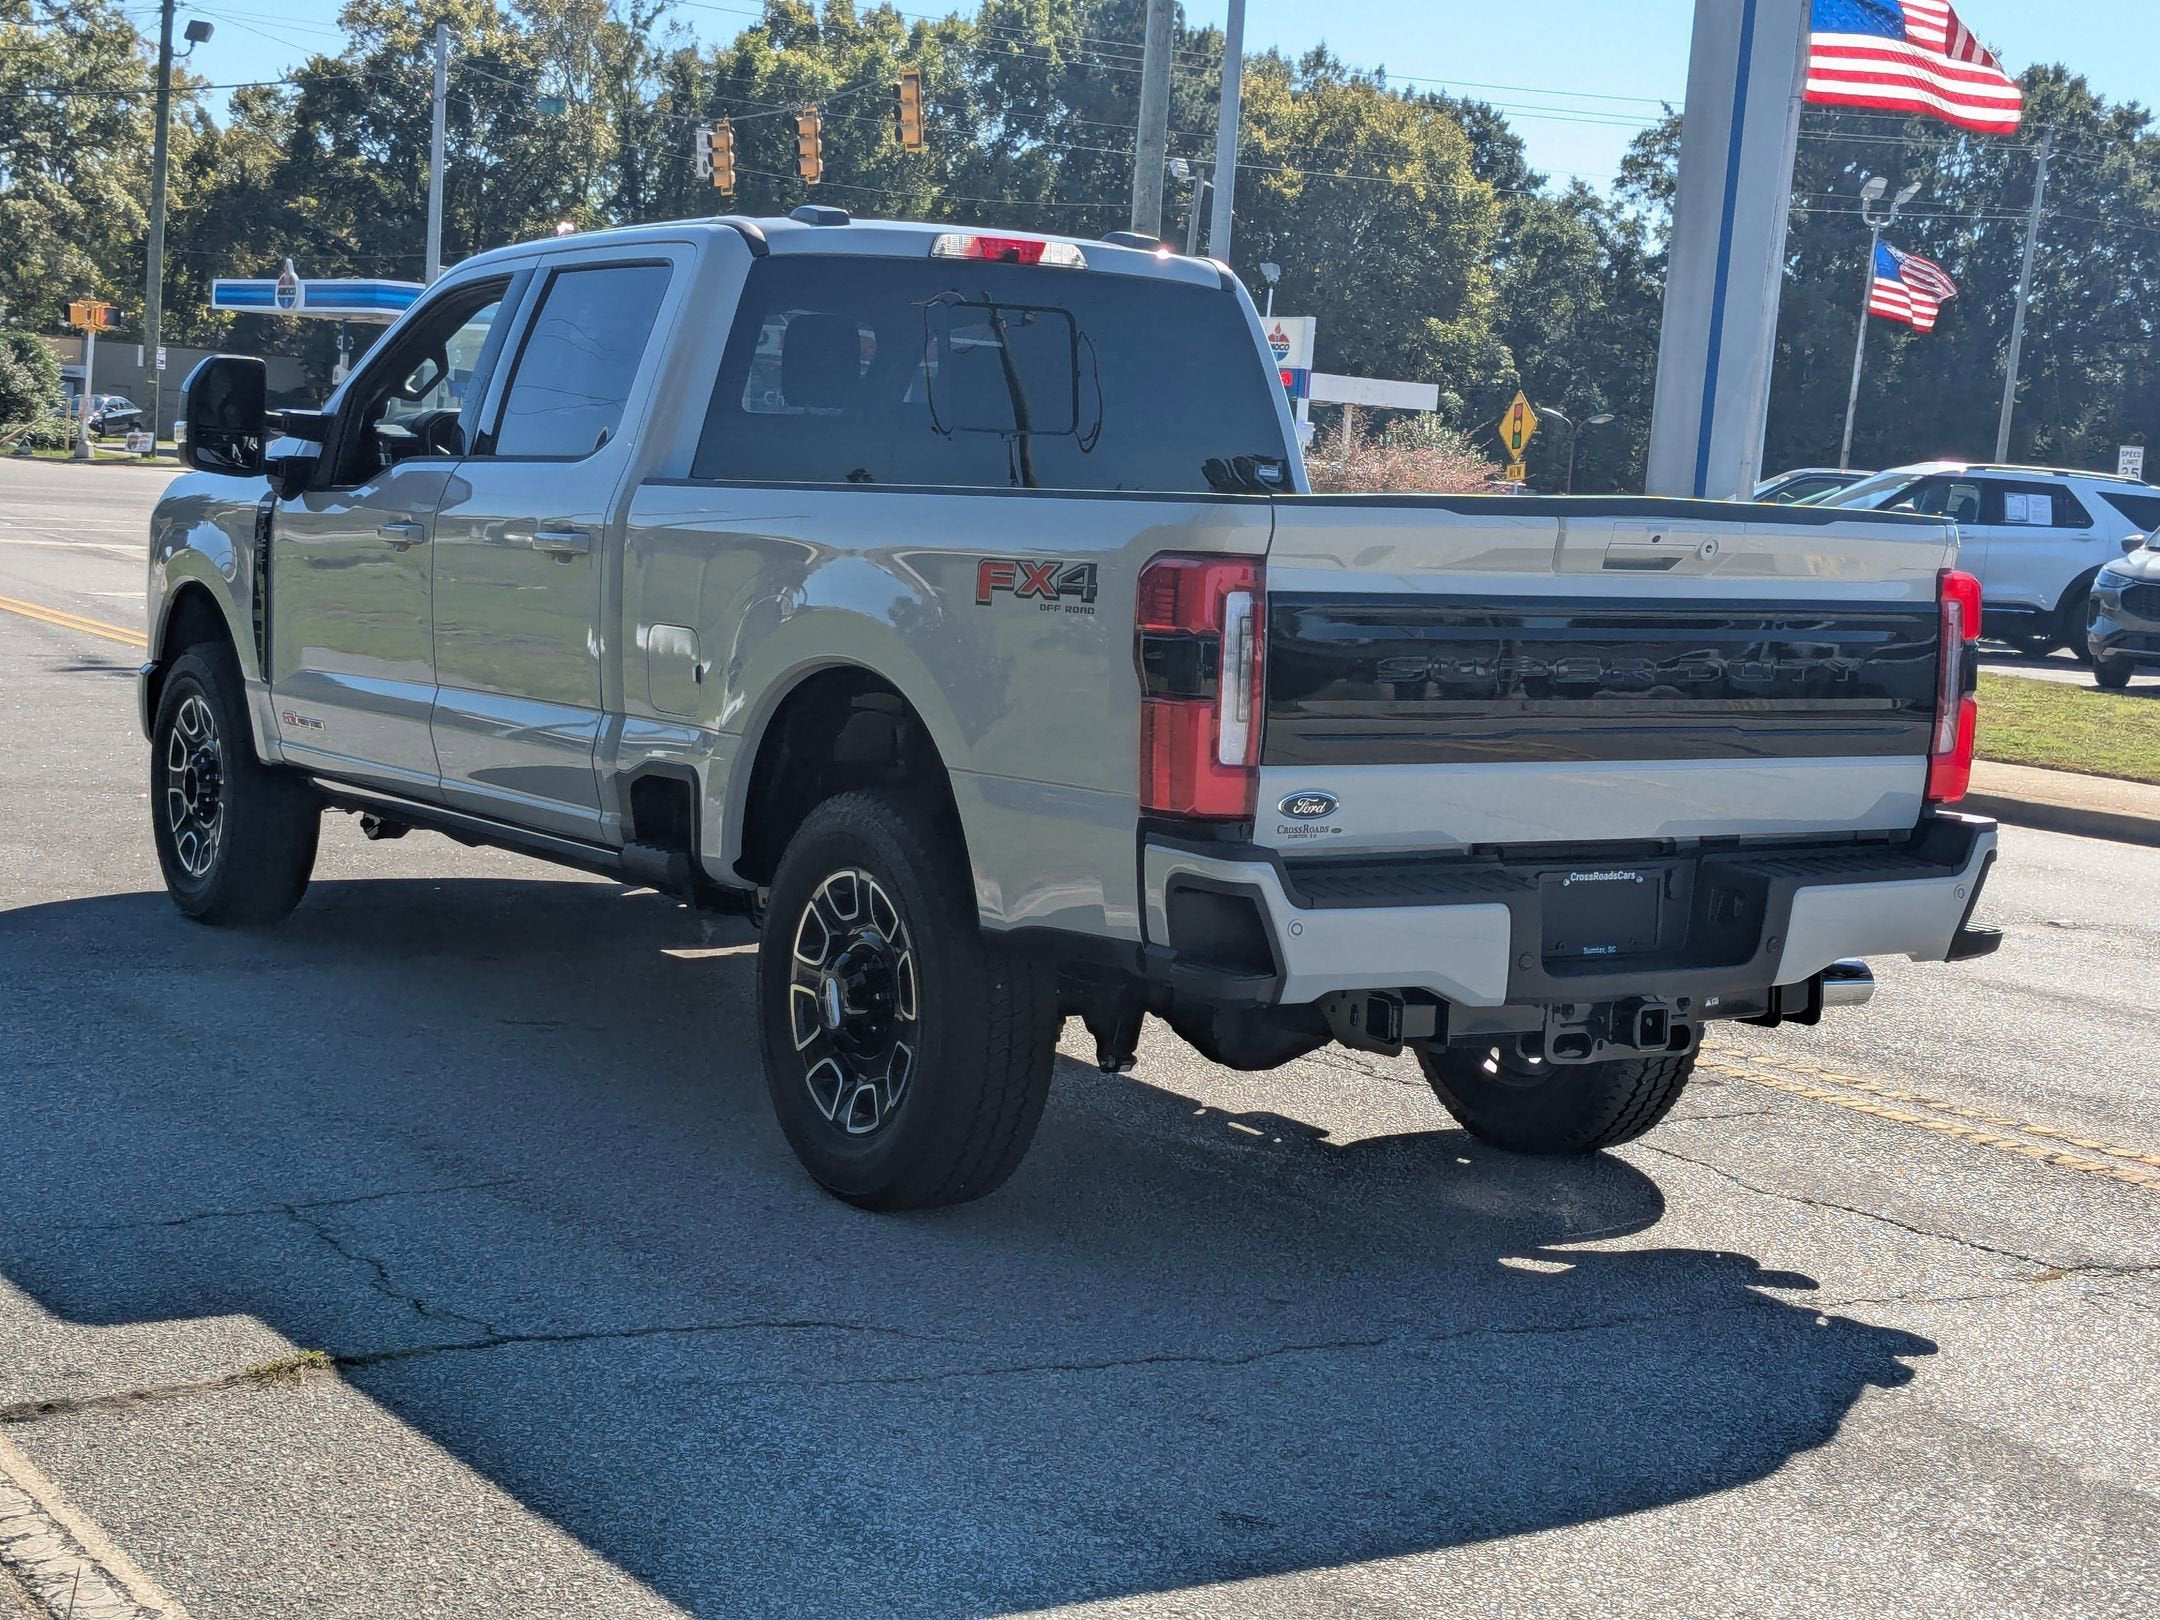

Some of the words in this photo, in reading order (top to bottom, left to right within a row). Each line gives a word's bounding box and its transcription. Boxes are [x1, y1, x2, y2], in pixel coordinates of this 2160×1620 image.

[2121, 450, 2141, 458] SPEED
[976, 558, 1098, 606] FX4
[1040, 603, 1061, 612] OFF
[1065, 605, 1095, 615] ROAD
[1293, 797, 1327, 814] Ford
[1570, 871, 1636, 882] CrossRoadsCars
